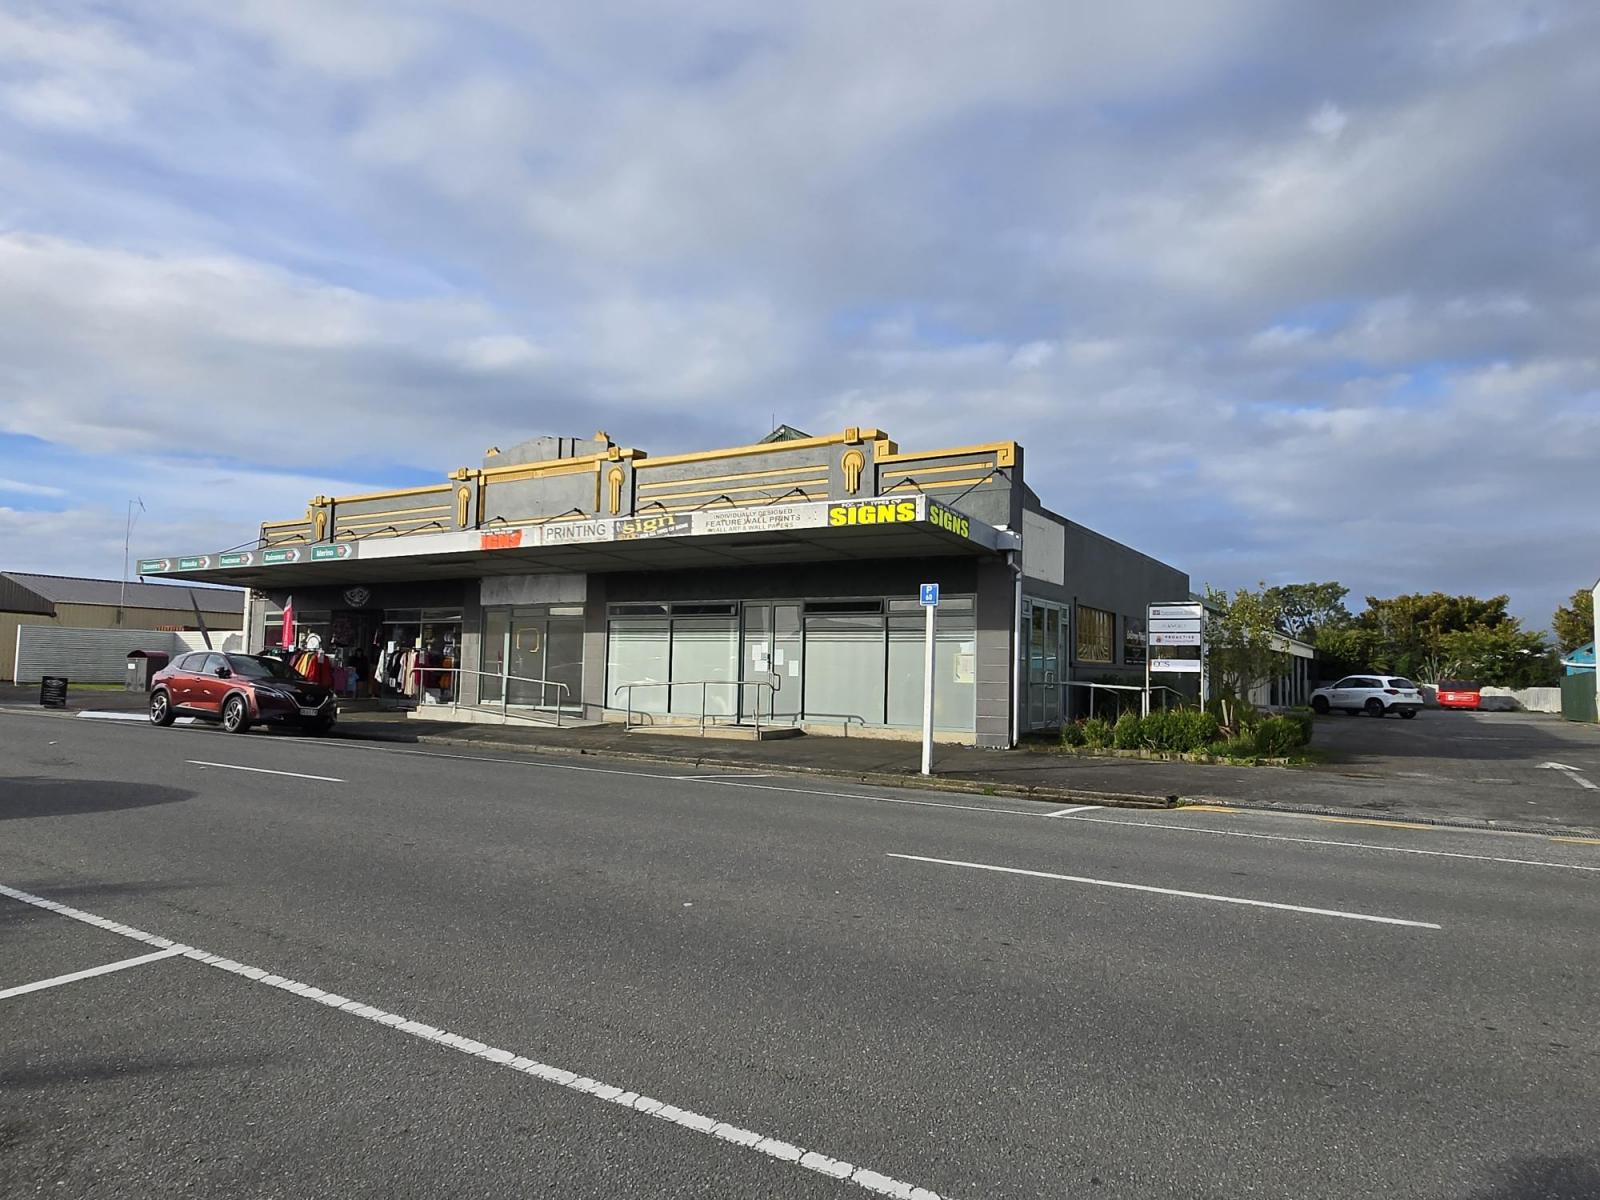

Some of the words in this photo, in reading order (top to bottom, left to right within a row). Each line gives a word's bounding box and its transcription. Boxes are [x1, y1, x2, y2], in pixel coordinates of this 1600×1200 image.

[705, 518, 740, 528] FEATURE
[743, 516, 767, 525] WALL
[769, 514, 801, 522] PRINTS
[713, 511, 756, 519] INDIVIDUALLY
[758, 508, 793, 516] DESIGNED
[829, 502, 915, 526] SIGNS
[929, 505, 969, 538] SIGNS
[546, 523, 606, 539] PRINTING
[623, 514, 675, 533] sign
[926, 585, 933, 593] P
